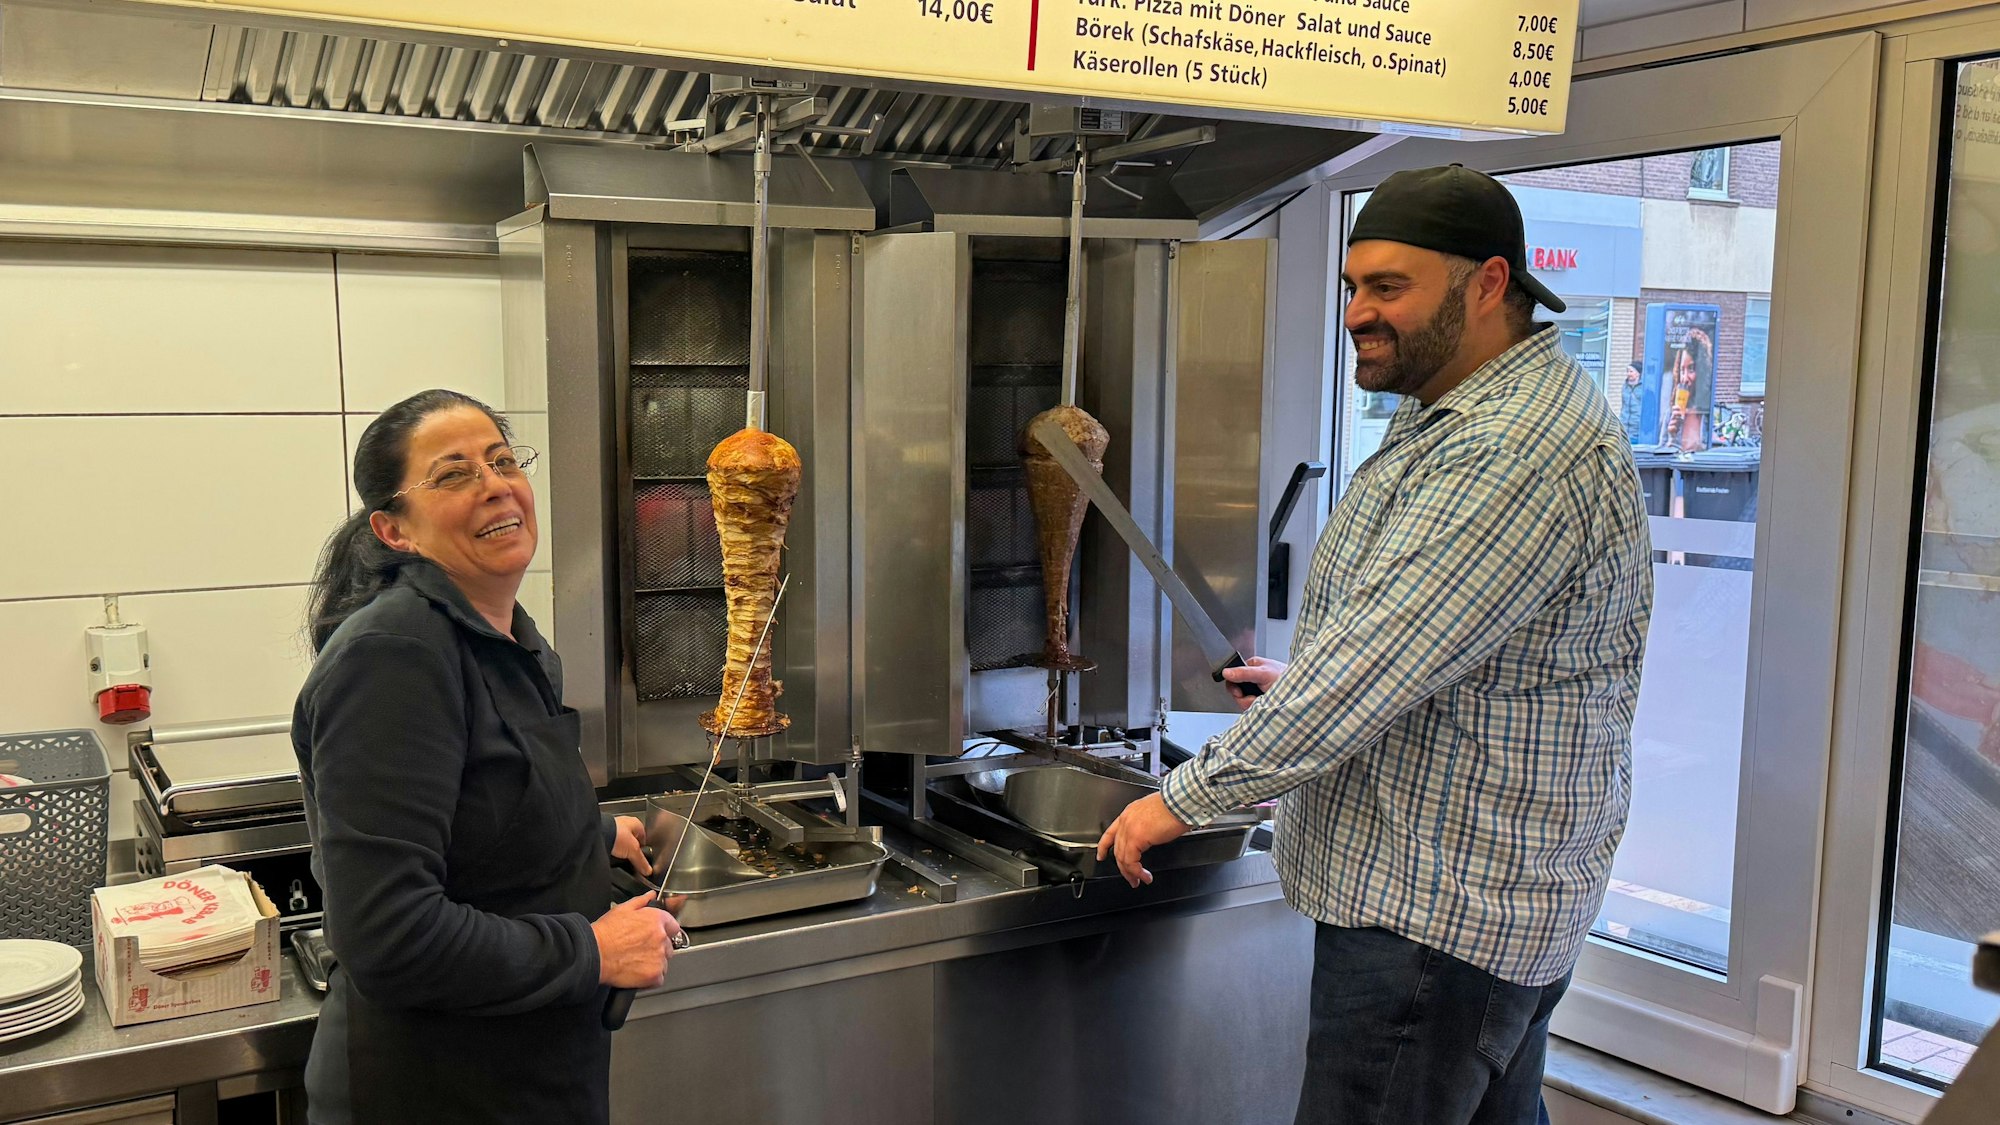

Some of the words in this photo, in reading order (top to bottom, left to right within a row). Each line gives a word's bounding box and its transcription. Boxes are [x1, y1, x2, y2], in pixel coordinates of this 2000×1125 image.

[918, 0, 994, 24] 14,00€
[1190, 0, 1222, 20] mit
[1229, 4, 1286, 28] Döner
[1297, 12, 1342, 35] Salat
[1347, 21, 1380, 40] und
[1385, 24, 1432, 46] Sauce
[1518, 15, 1557, 34] 7,00€
[1076, 17, 1135, 42] Börek
[1372, 52, 1447, 78] o.Spinat)
[1513, 41, 1555, 62] 8,50€
[1073, 50, 1178, 78] Käserollen
[1185, 60, 1203, 83] (5
[1209, 63, 1268, 90] Stück)
[1509, 70, 1551, 89] 4,00€
[1508, 97, 1548, 116] 5,00€
[1534, 247, 1578, 269] BANK
[163, 879, 217, 903] DÖNER
